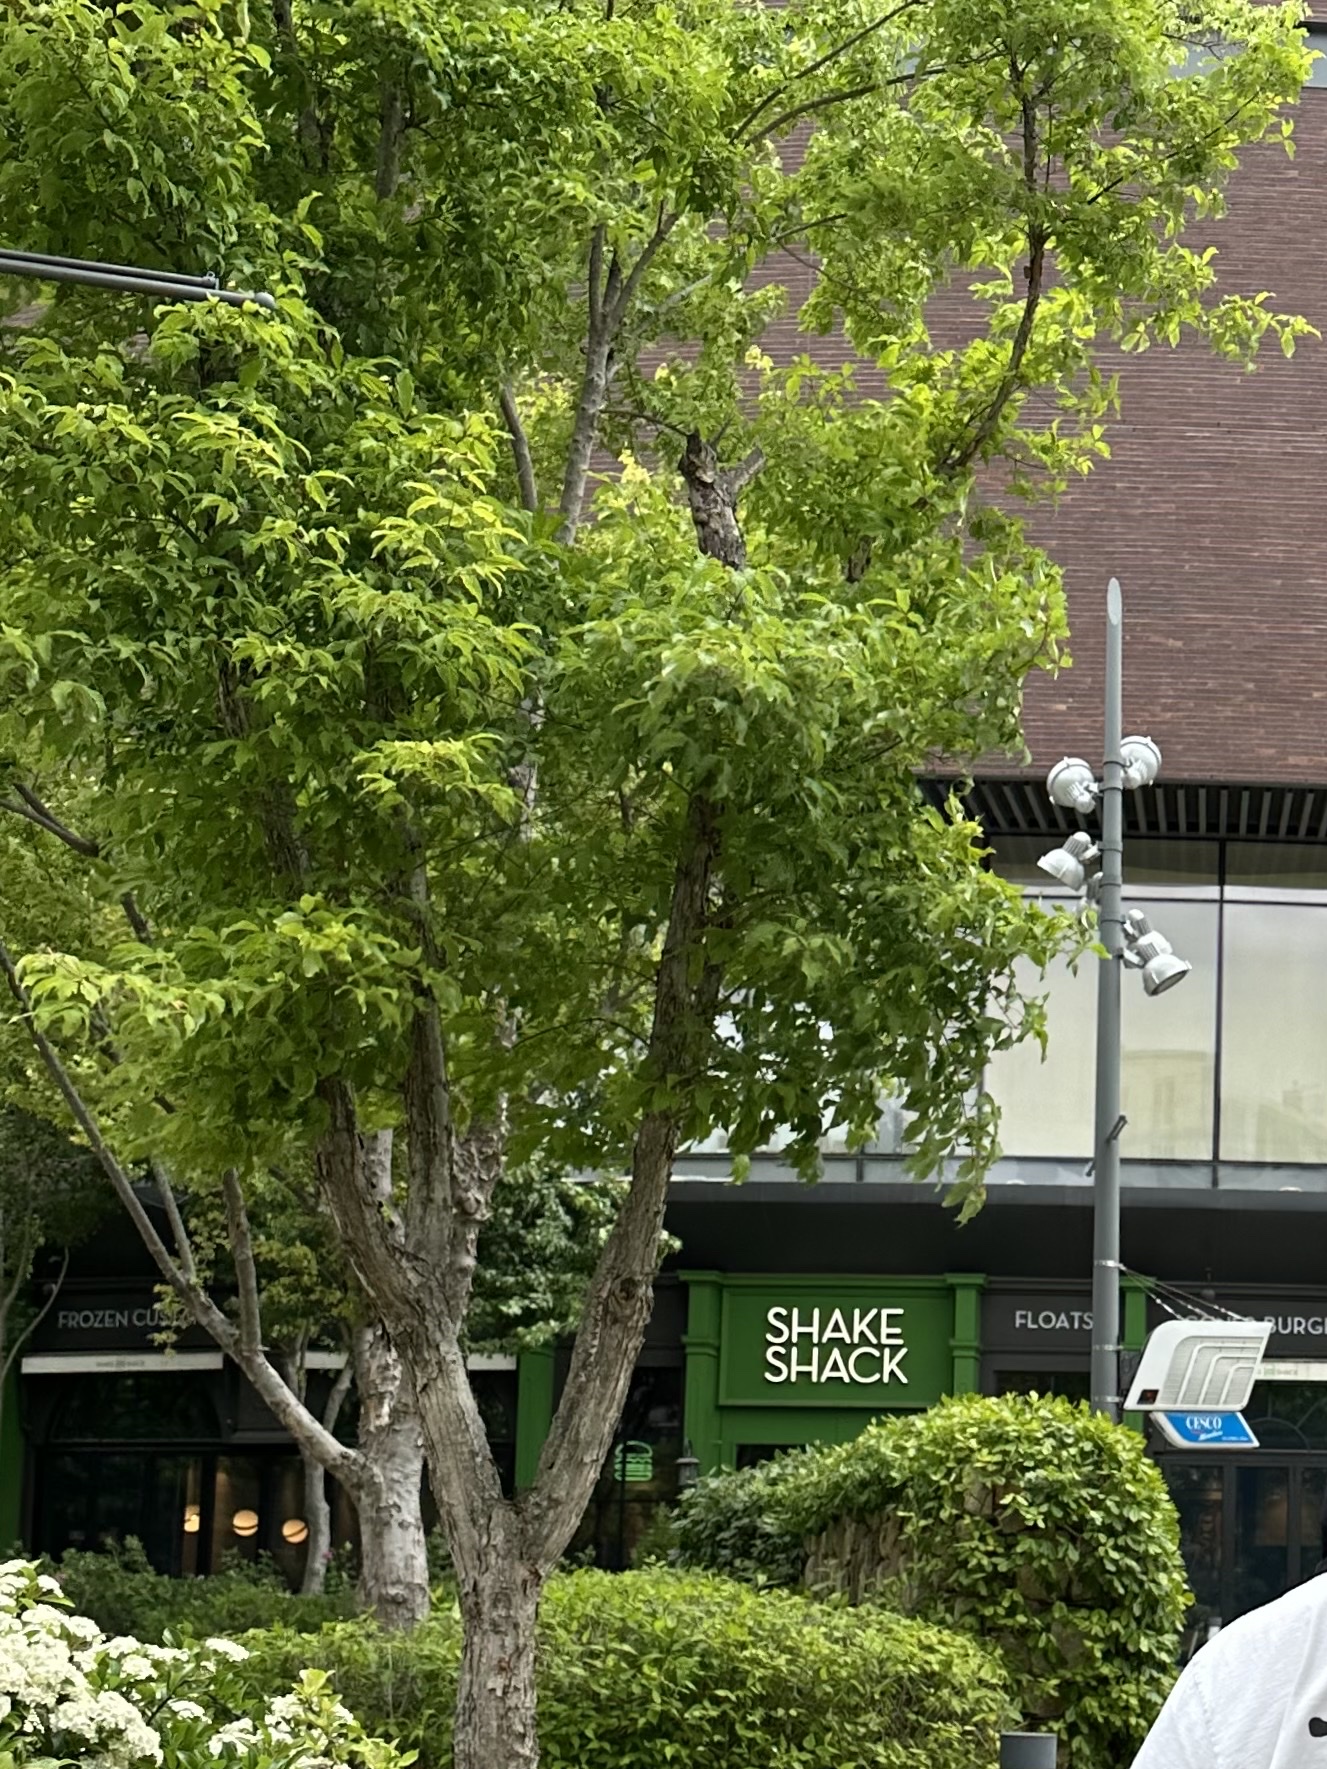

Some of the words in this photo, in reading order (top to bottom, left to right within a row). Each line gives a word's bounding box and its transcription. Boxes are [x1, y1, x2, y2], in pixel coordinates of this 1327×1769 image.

[57, 1310, 129, 1329] FROZEN
[765, 1306, 905, 1345] SHAKE
[1014, 1310, 1095, 1330] FLOATS
[763, 1345, 909, 1384] SHACK
